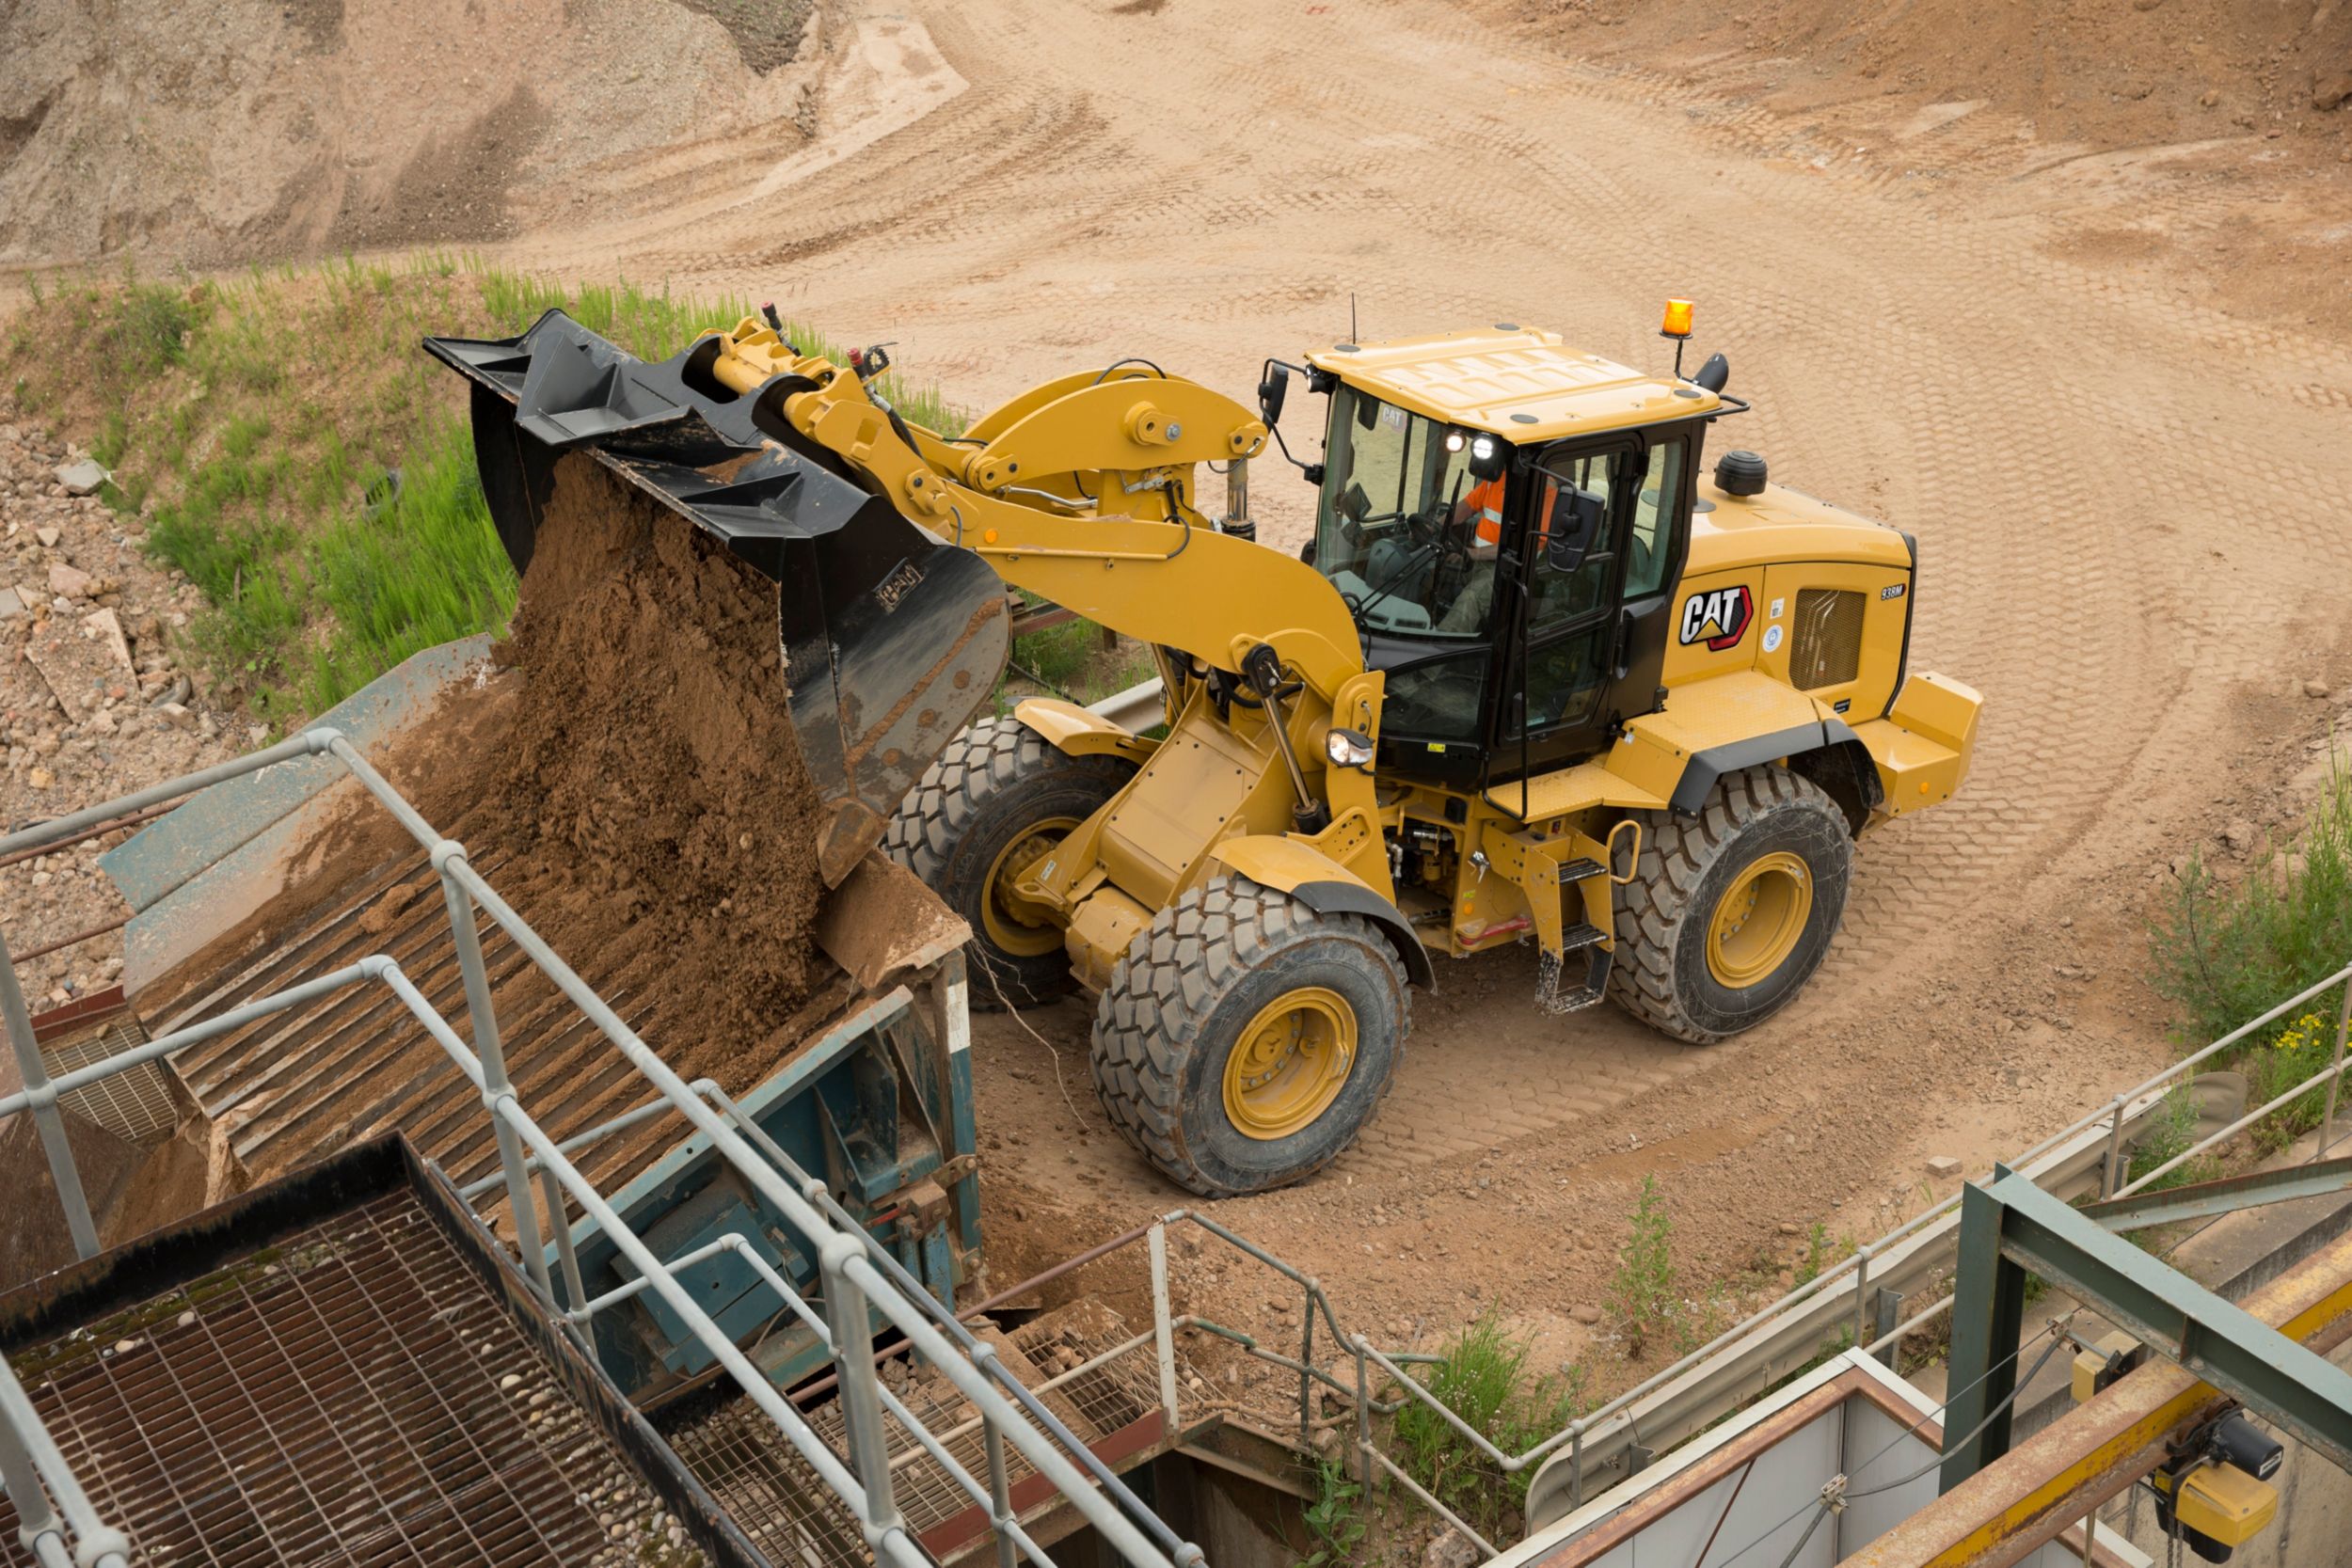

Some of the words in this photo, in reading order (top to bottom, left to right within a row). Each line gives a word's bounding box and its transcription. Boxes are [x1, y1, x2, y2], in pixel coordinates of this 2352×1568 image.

[1383, 406, 1401, 427] CAT
[1881, 584, 1903, 600] 938M
[1680, 588, 1740, 644] CAT
